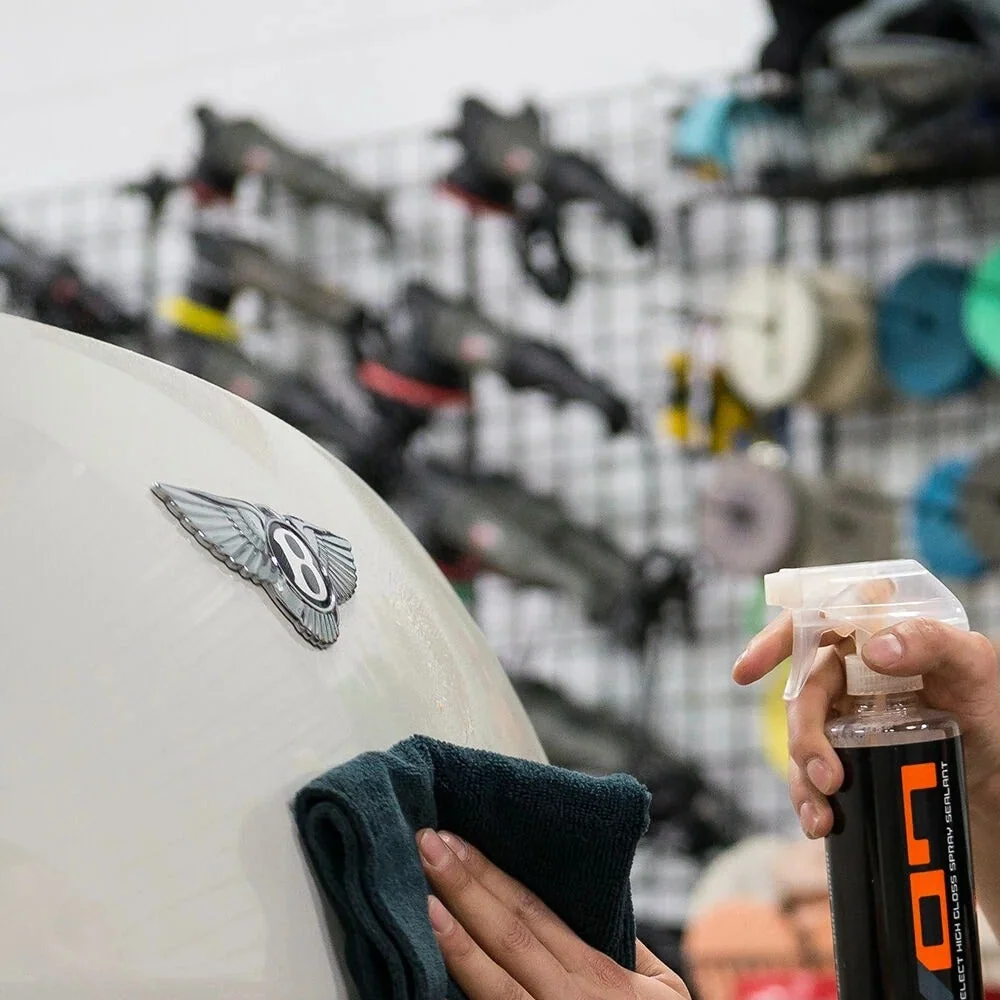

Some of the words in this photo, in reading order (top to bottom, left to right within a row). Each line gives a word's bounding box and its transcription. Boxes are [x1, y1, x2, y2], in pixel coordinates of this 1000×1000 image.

[940, 761, 953, 824] SEALANT
[946, 826, 957, 872] SPRAY
[949, 874, 960, 920] GLOSS
[954, 922, 963, 953] HIGH
